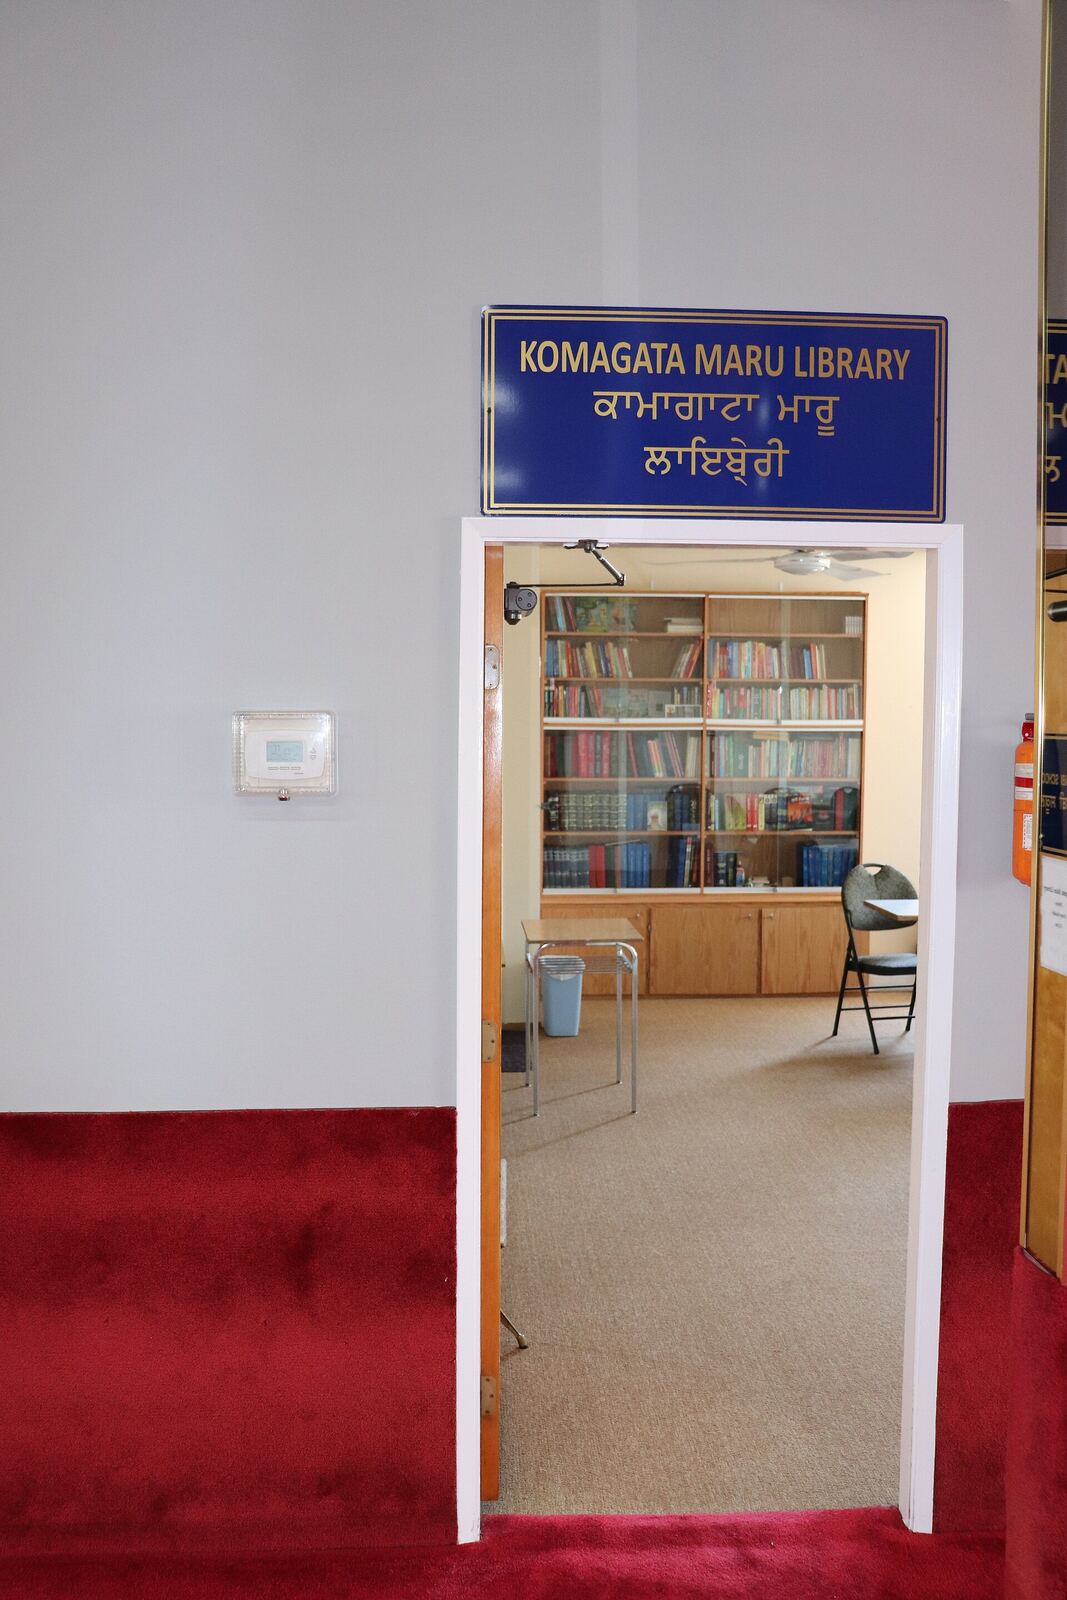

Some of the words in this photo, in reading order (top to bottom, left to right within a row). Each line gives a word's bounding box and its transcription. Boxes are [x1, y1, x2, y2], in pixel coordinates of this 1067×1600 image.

[520, 340, 686, 374] KOMAGATA
[695, 343, 784, 377] MARU
[794, 345, 911, 381] LIBRARY
[593, 391, 760, 421] ਕਾਮਾਗਾਟਾ
[776, 395, 840, 437] ਮਾਰੂ
[643, 435, 790, 487] ਲਾਇਬ੍ਰੇਰੀ
